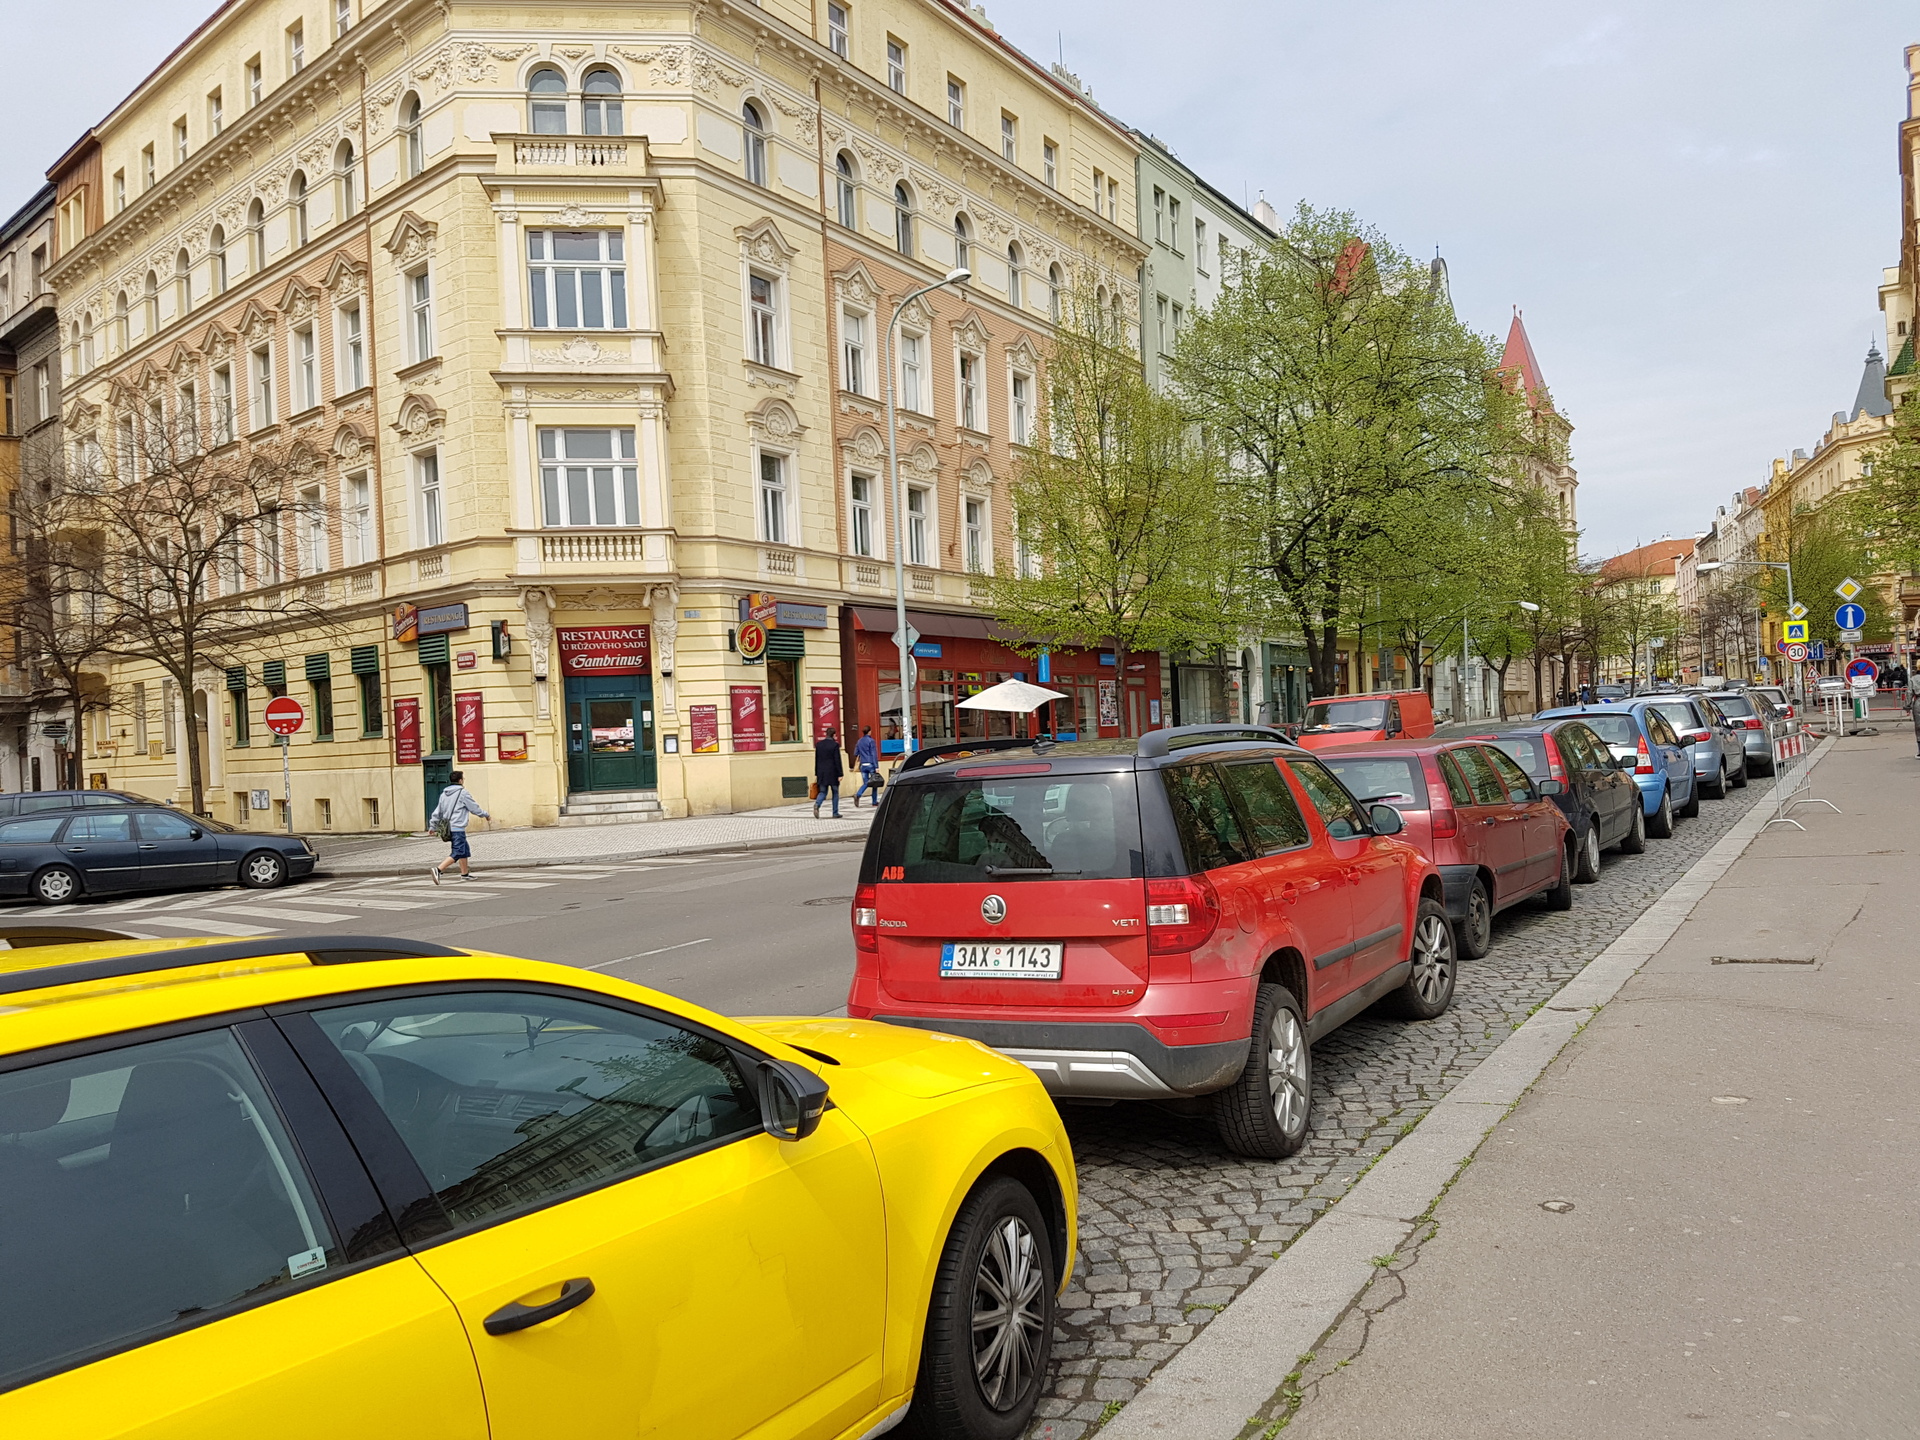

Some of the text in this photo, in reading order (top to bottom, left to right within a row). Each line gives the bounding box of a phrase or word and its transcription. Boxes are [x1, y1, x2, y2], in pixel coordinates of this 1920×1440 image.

[424, 611, 463, 625] RESTAURACE
[783, 610, 826, 622] RESTAURACE
[561, 629, 646, 641] RESTAURACE
[562, 641, 648, 651] U RŮŽOVÉHO SADU
[1790, 648, 1803, 657] 30
[568, 654, 644, 669] Gambrinus
[881, 866, 905, 881] ABB
[879, 919, 908, 928] ŠKODA
[1112, 919, 1140, 927] YETI
[957, 946, 1052, 968] 3AX 1143
